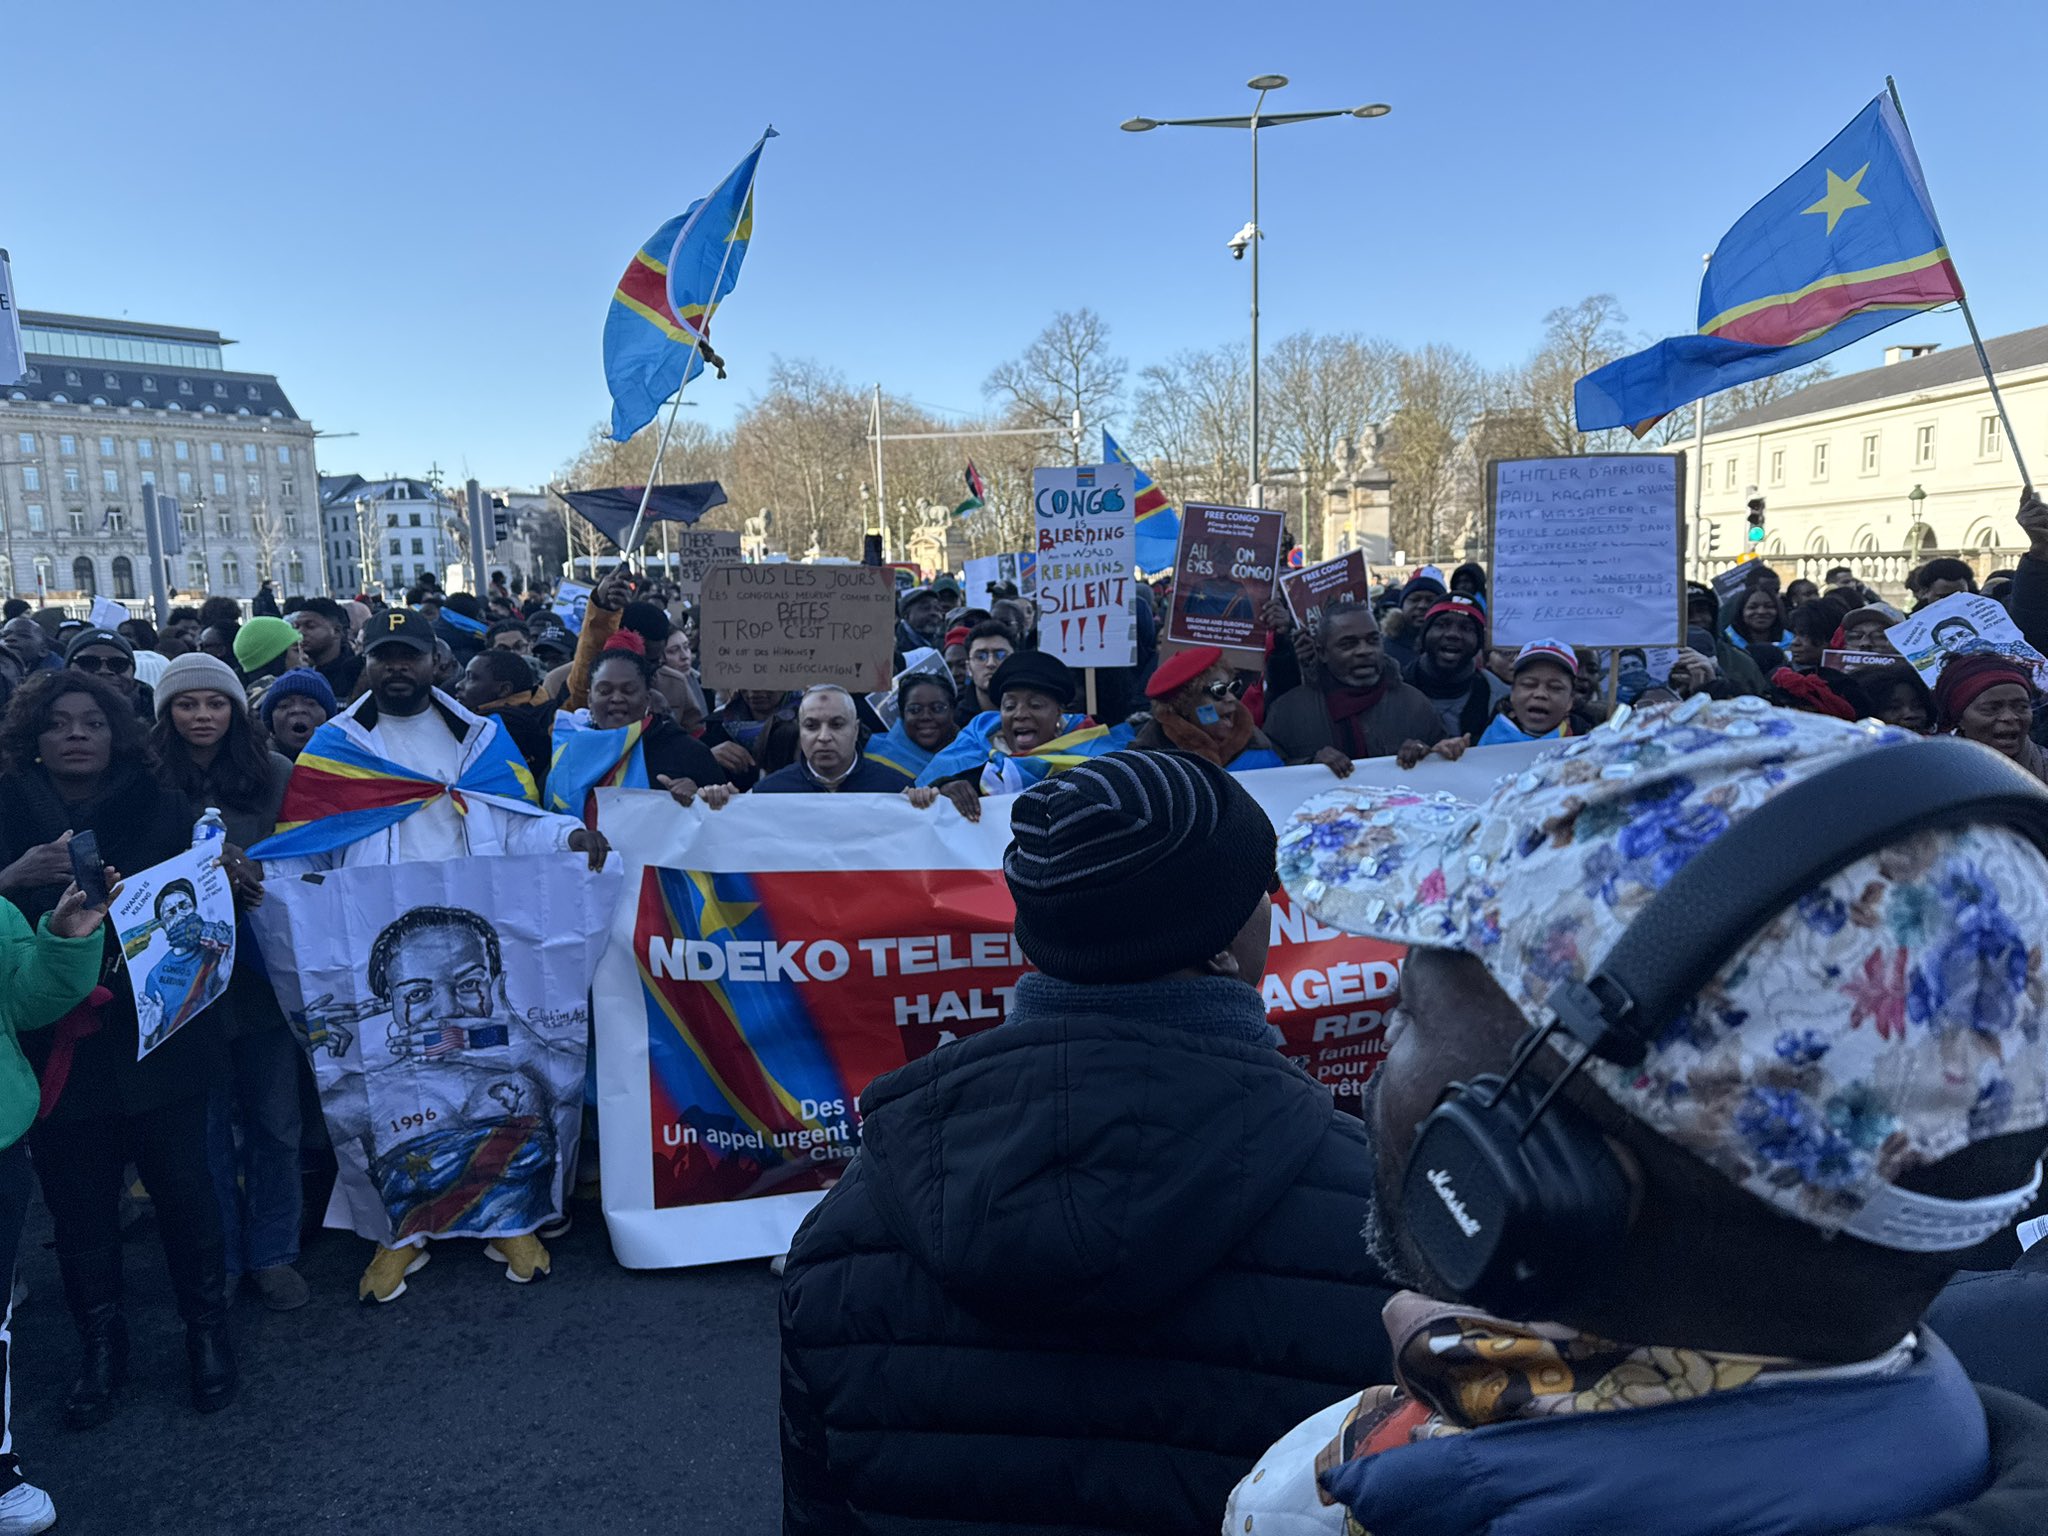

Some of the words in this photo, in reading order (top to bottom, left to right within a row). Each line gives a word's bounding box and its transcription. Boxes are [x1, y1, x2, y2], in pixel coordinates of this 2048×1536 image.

[1502, 467, 1582, 484] L'HITLER
[1589, 464, 1667, 480] D'AFRIQUE
[1035, 483, 1126, 519] CONGO
[1499, 489, 1545, 504] PAUL
[1552, 487, 1618, 502] KAGAME
[1204, 510, 1225, 520] FREE
[1226, 512, 1260, 523] CONGO
[1499, 509, 1533, 520] FAIT
[1542, 505, 1634, 520] MASSACRER
[1641, 505, 1657, 515] LE
[1075, 520, 1087, 529] IS
[1498, 527, 1549, 538] PEUPLE
[1555, 525, 1630, 536] CONGOLAIS
[1640, 524, 1671, 533] DANS
[681, 532, 715, 548] THERE
[1038, 526, 1124, 553] BLEEDING
[680, 547, 709, 558] COMES
[712, 548, 719, 557] A
[1073, 547, 1114, 558] WORLD
[1236, 547, 1255, 563] ON
[1041, 560, 1125, 581] REMAINS
[1186, 559, 1214, 575] EYES
[1231, 563, 1273, 582] CONGO
[1301, 571, 1321, 582] FREE
[1321, 559, 1349, 575] CONGO
[716, 567, 776, 586] TOUS
[784, 568, 817, 586] LES
[825, 571, 876, 590] JOURS
[709, 590, 729, 601] LES
[737, 591, 789, 601] CONGOLAIS
[840, 593, 871, 602] COMME
[875, 594, 891, 603] DES
[1041, 577, 1129, 614] SILENT
[389, 613, 405, 631] P
[712, 619, 774, 640] TROP
[784, 624, 825, 640] C'EST
[827, 621, 873, 641] TROP
[718, 648, 731, 657] ON
[736, 648, 748, 656] EST
[755, 648, 769, 657] DES
[1842, 655, 1862, 664] FREE
[716, 662, 742, 676] PAS
[754, 663, 768, 675] DE
[120, 886, 144, 916] RWANDA
[142, 881, 150, 890] IS
[132, 892, 152, 916] KILLING
[649, 936, 850, 982] NDEKO
[1261, 958, 1405, 1014] AGÉD
[1317, 1060, 1368, 1080] pour
[801, 1098, 845, 1121] Des
[390, 1107, 437, 1133] 1996
[663, 1124, 697, 1146] Un
[706, 1128, 764, 1150] appel
[773, 1119, 849, 1149] urgent
[1426, 1169, 1482, 1237] Marshall
